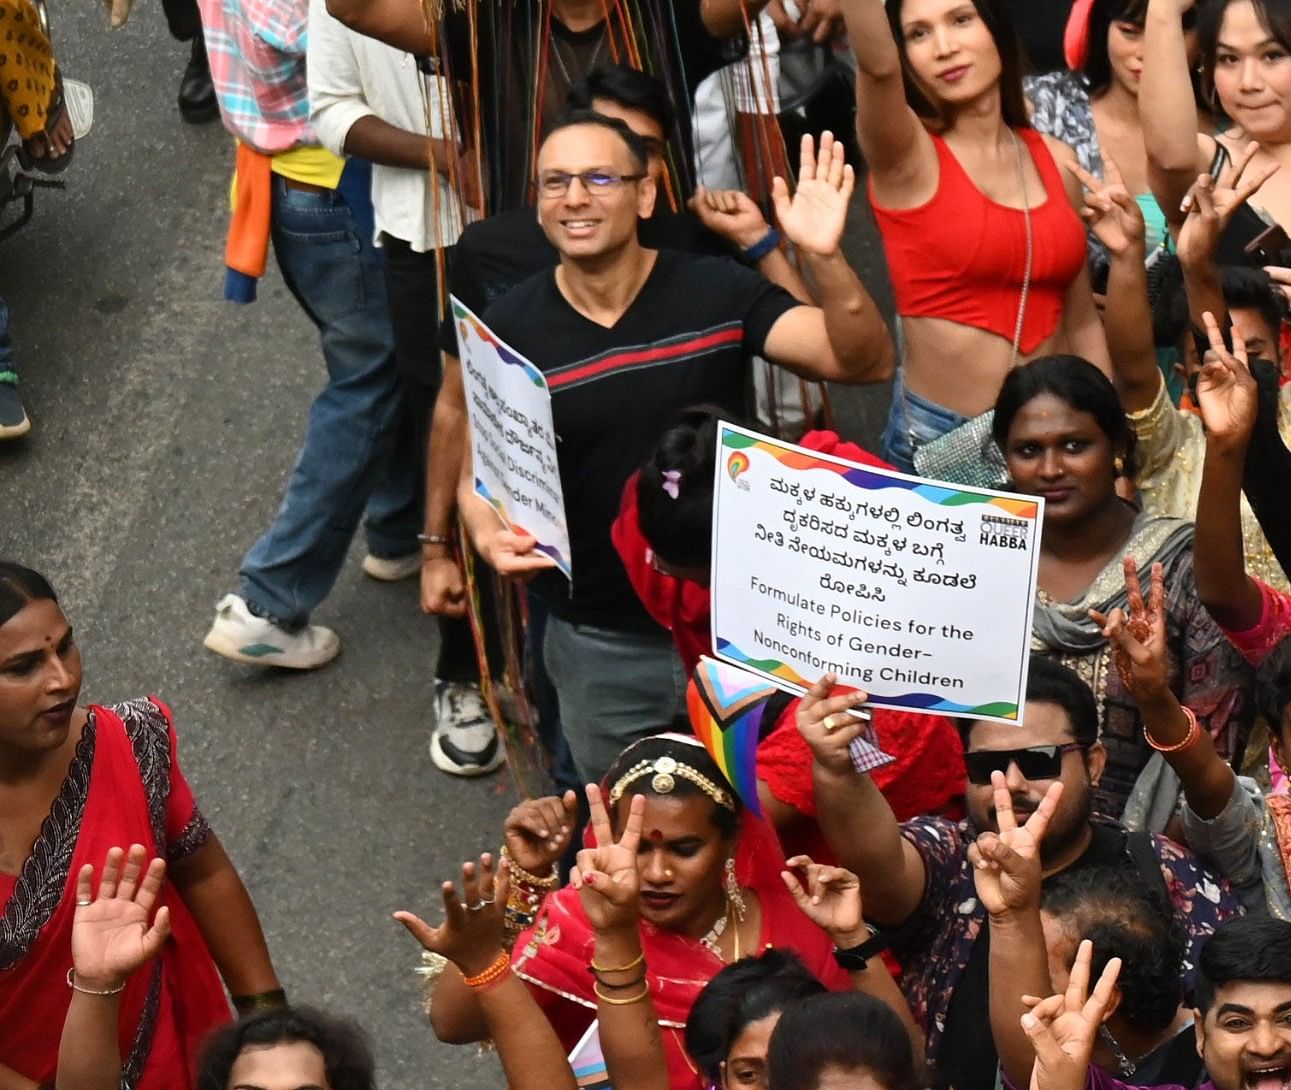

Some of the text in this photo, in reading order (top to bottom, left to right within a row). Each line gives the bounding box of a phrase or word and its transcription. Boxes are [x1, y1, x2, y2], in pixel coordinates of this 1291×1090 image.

[770, 477, 816, 506] ಮಕ್ಕಳ
[820, 493, 901, 530] ಹಕ್ಕುಗಳಲ್ಲಿ
[853, 529, 907, 556] ಮಕ್ಕಳ
[980, 532, 1027, 551] HABBA
[751, 576, 974, 640] Formulate Policies for the
[777, 613, 821, 642] Rights
[826, 632, 844, 648] of
[753, 629, 964, 689] Nonconforming Children
